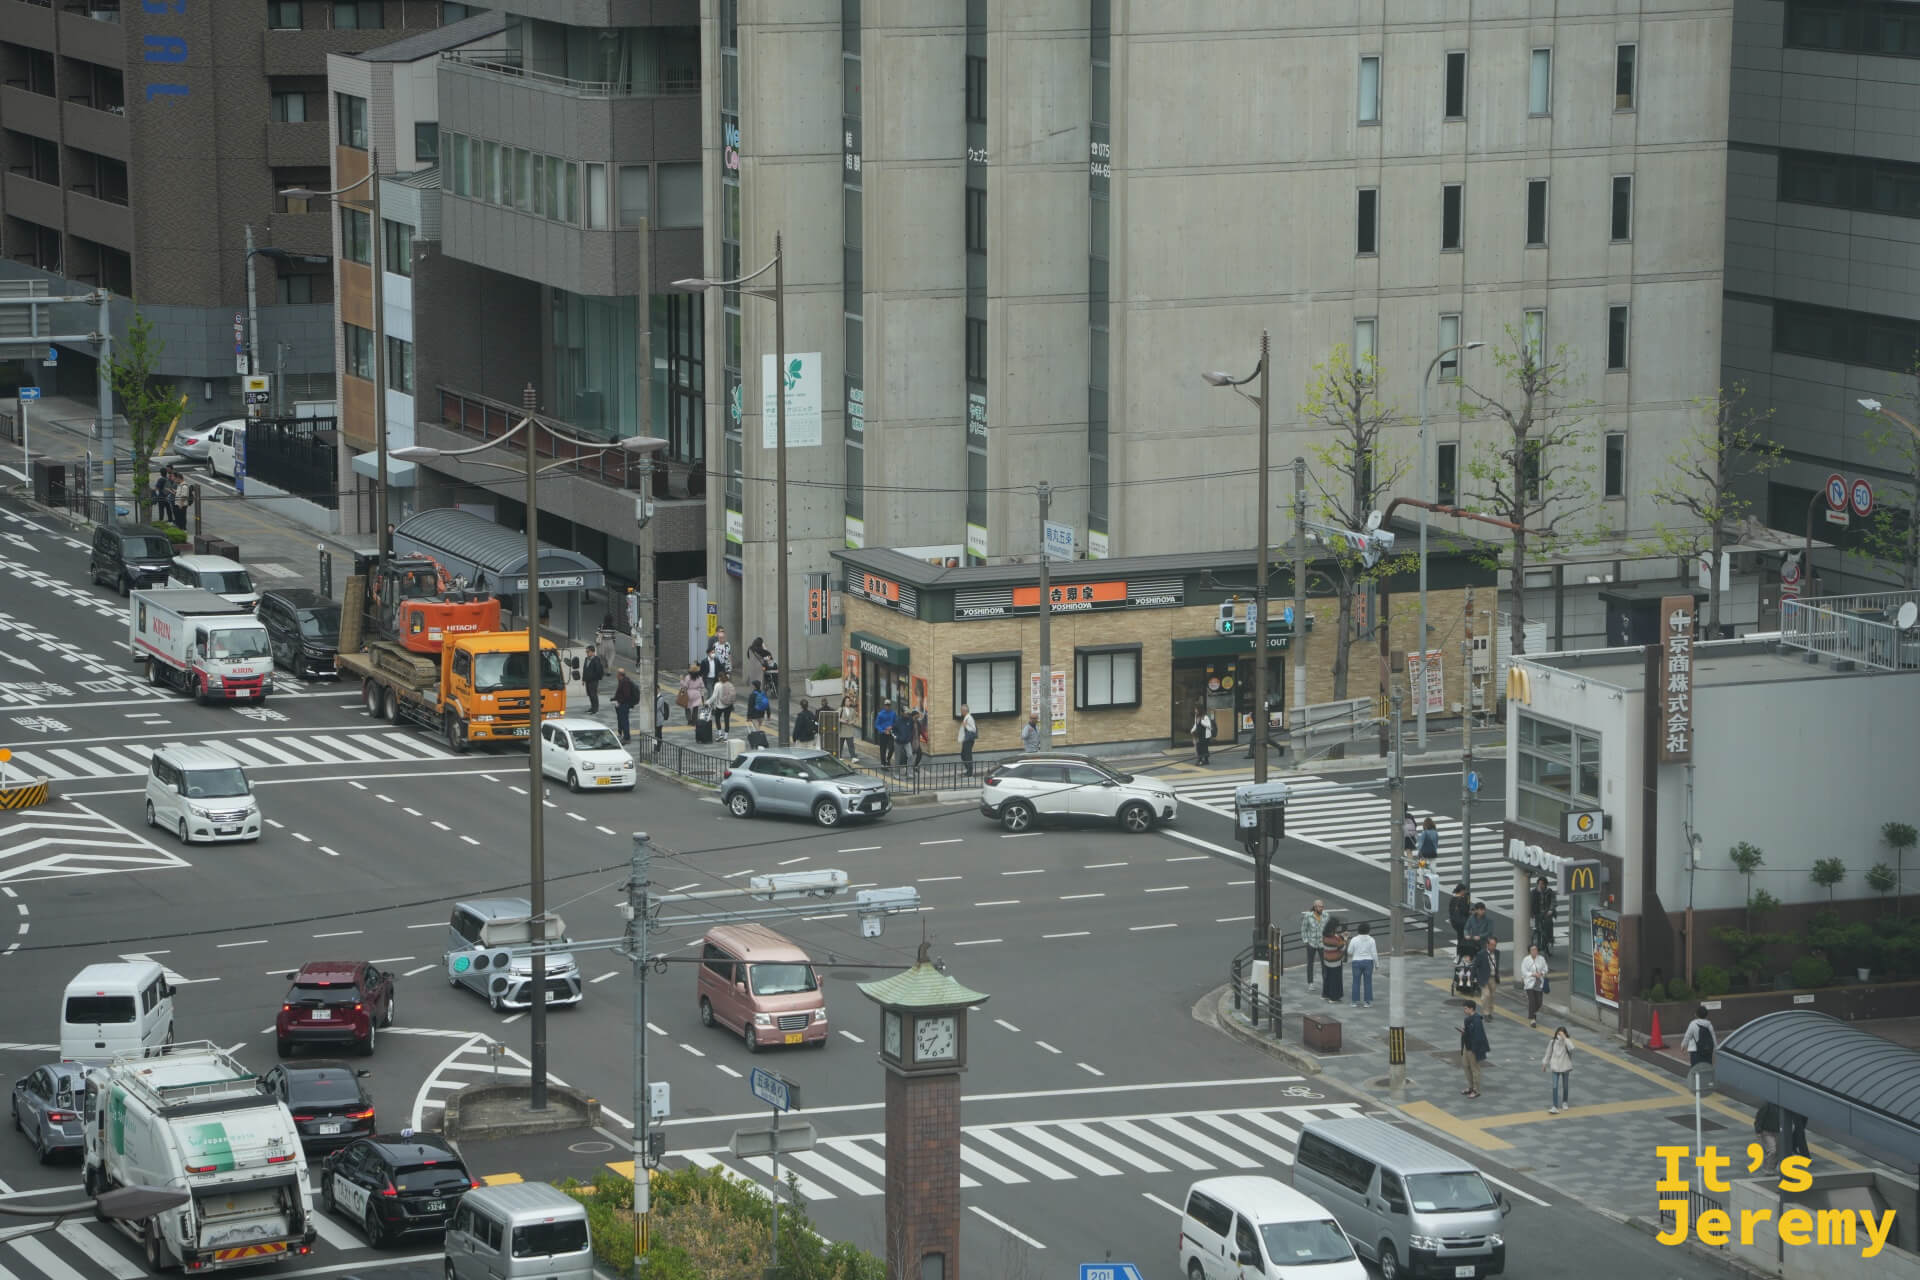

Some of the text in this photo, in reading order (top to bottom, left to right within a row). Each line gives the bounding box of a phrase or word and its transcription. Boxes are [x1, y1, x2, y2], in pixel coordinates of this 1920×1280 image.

[1855, 488, 1868, 506] 50
[576, 576, 582, 585] 2
[1135, 595, 1176, 605] YOSHINOYA
[962, 607, 1005, 616] YOSHINOYA
[153, 616, 171, 640] KIRIN
[1270, 638, 1287, 647] OUT
